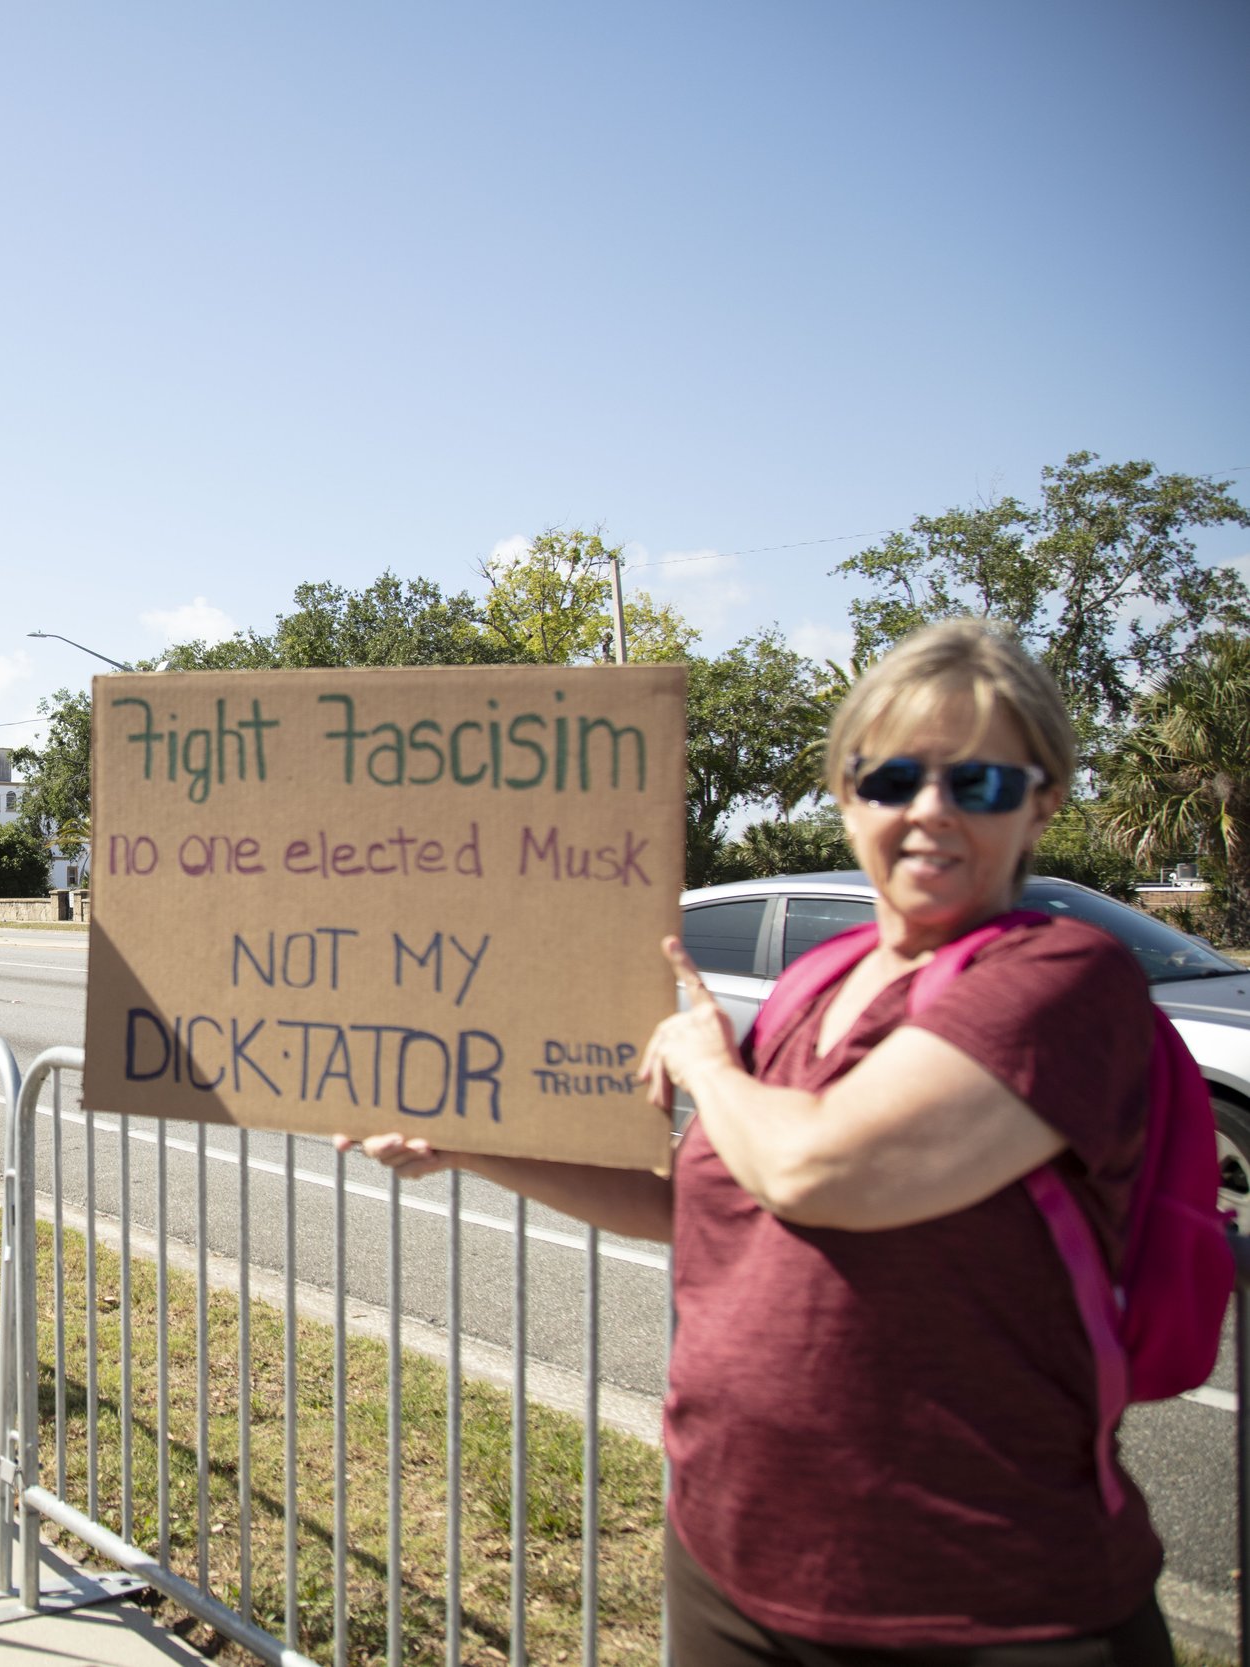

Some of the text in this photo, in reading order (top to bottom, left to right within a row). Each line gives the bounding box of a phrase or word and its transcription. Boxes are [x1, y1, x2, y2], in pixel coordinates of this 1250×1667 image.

[111, 690, 646, 803] Fight Fascisim
[109, 822, 652, 887] no one elected Musk
[232, 927, 491, 1007] NOT MY
